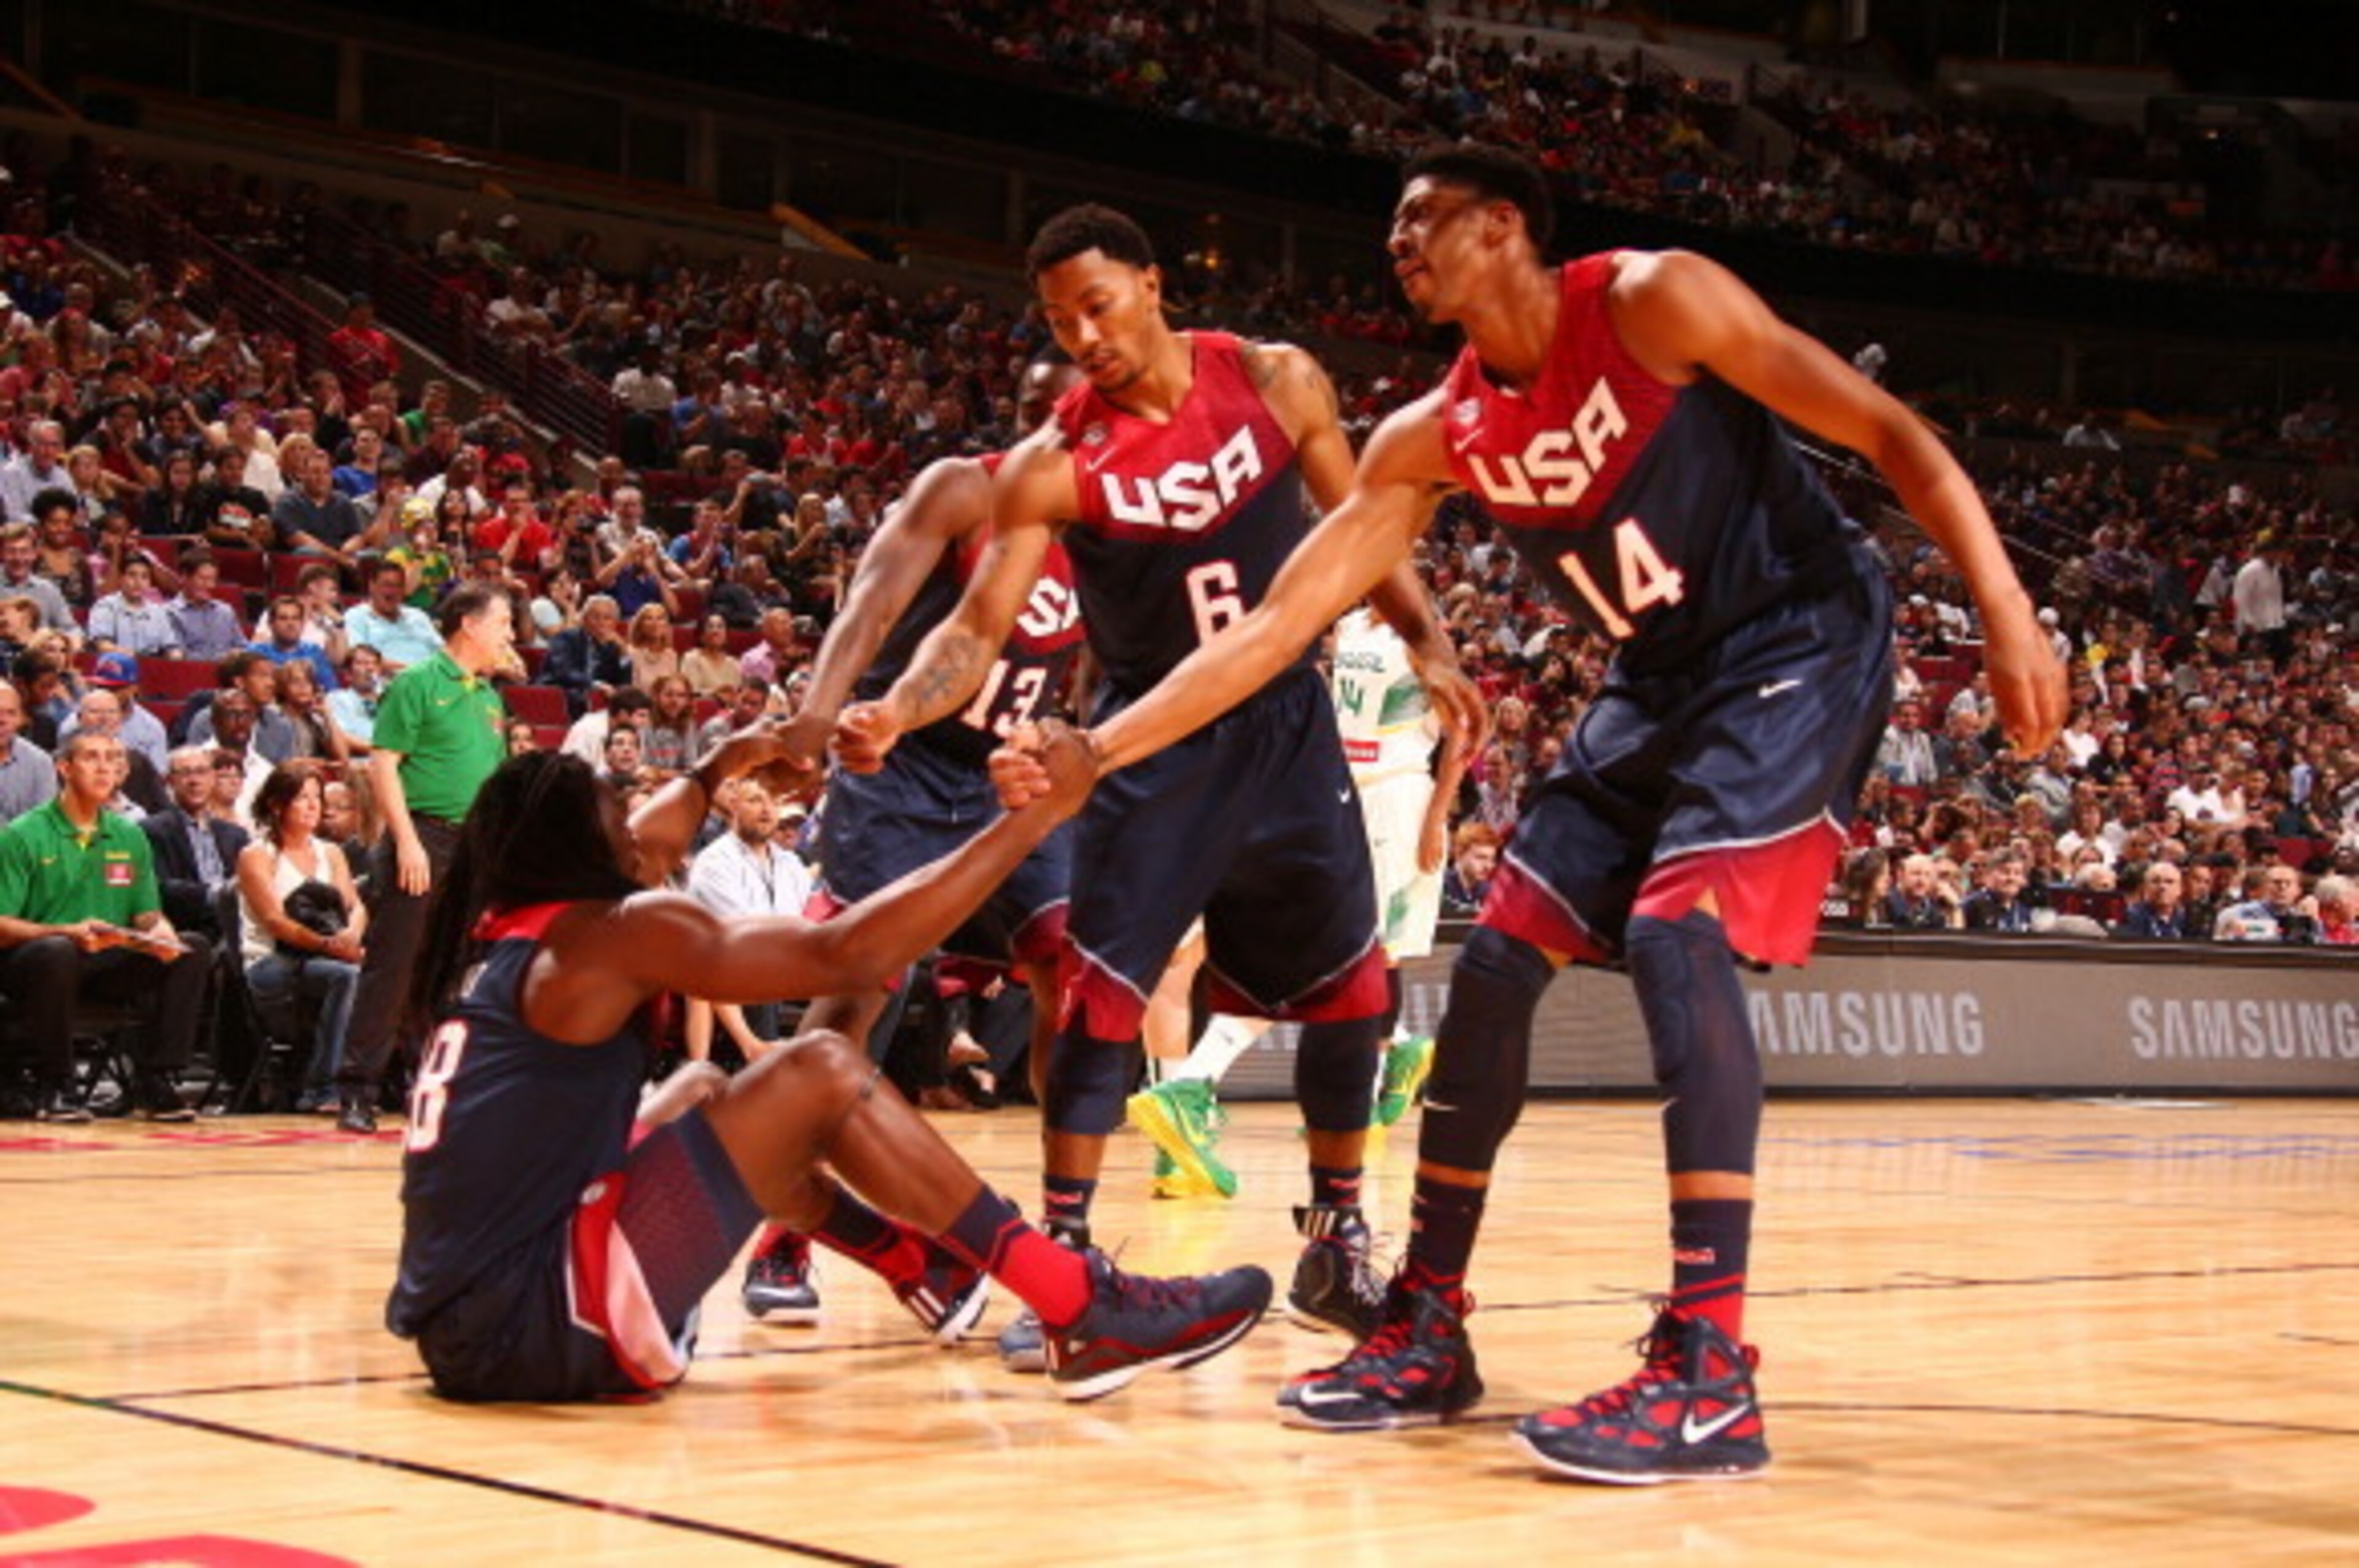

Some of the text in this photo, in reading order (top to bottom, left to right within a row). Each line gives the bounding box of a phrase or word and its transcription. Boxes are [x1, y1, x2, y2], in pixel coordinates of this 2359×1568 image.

[1101, 425, 1262, 531] USA
[1467, 375, 1628, 506] USA
[1186, 560, 1246, 649] 6
[1558, 517, 1684, 638] 14
[960, 658, 1047, 738] 13
[1747, 990, 1984, 1057] AMSUNG
[2127, 995, 2359, 1059] SAMSUNG
